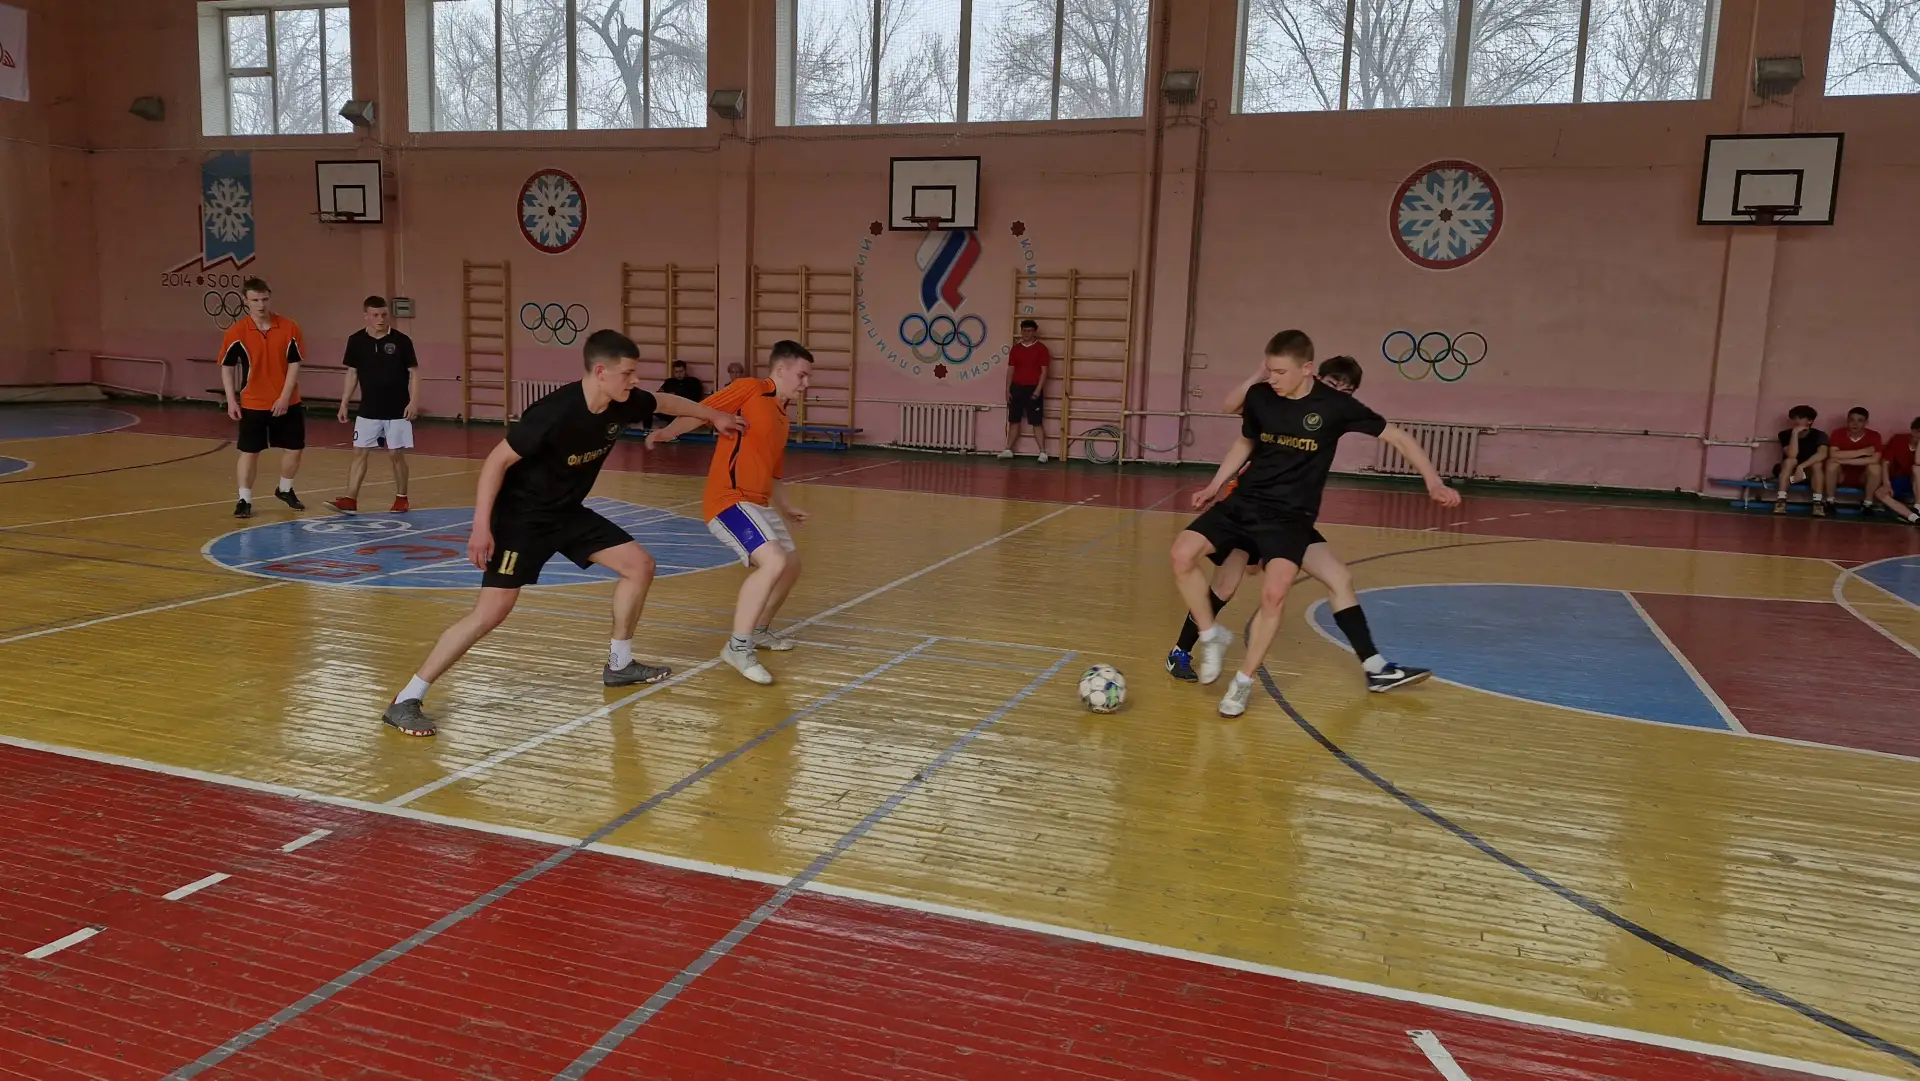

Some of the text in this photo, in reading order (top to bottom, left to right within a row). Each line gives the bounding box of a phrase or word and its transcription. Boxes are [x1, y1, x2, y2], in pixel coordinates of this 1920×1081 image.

[161, 273, 257, 288] 2014 SOC
[1277, 434, 1319, 452] ЮНОСТЬ
[499, 550, 519, 576] 11
